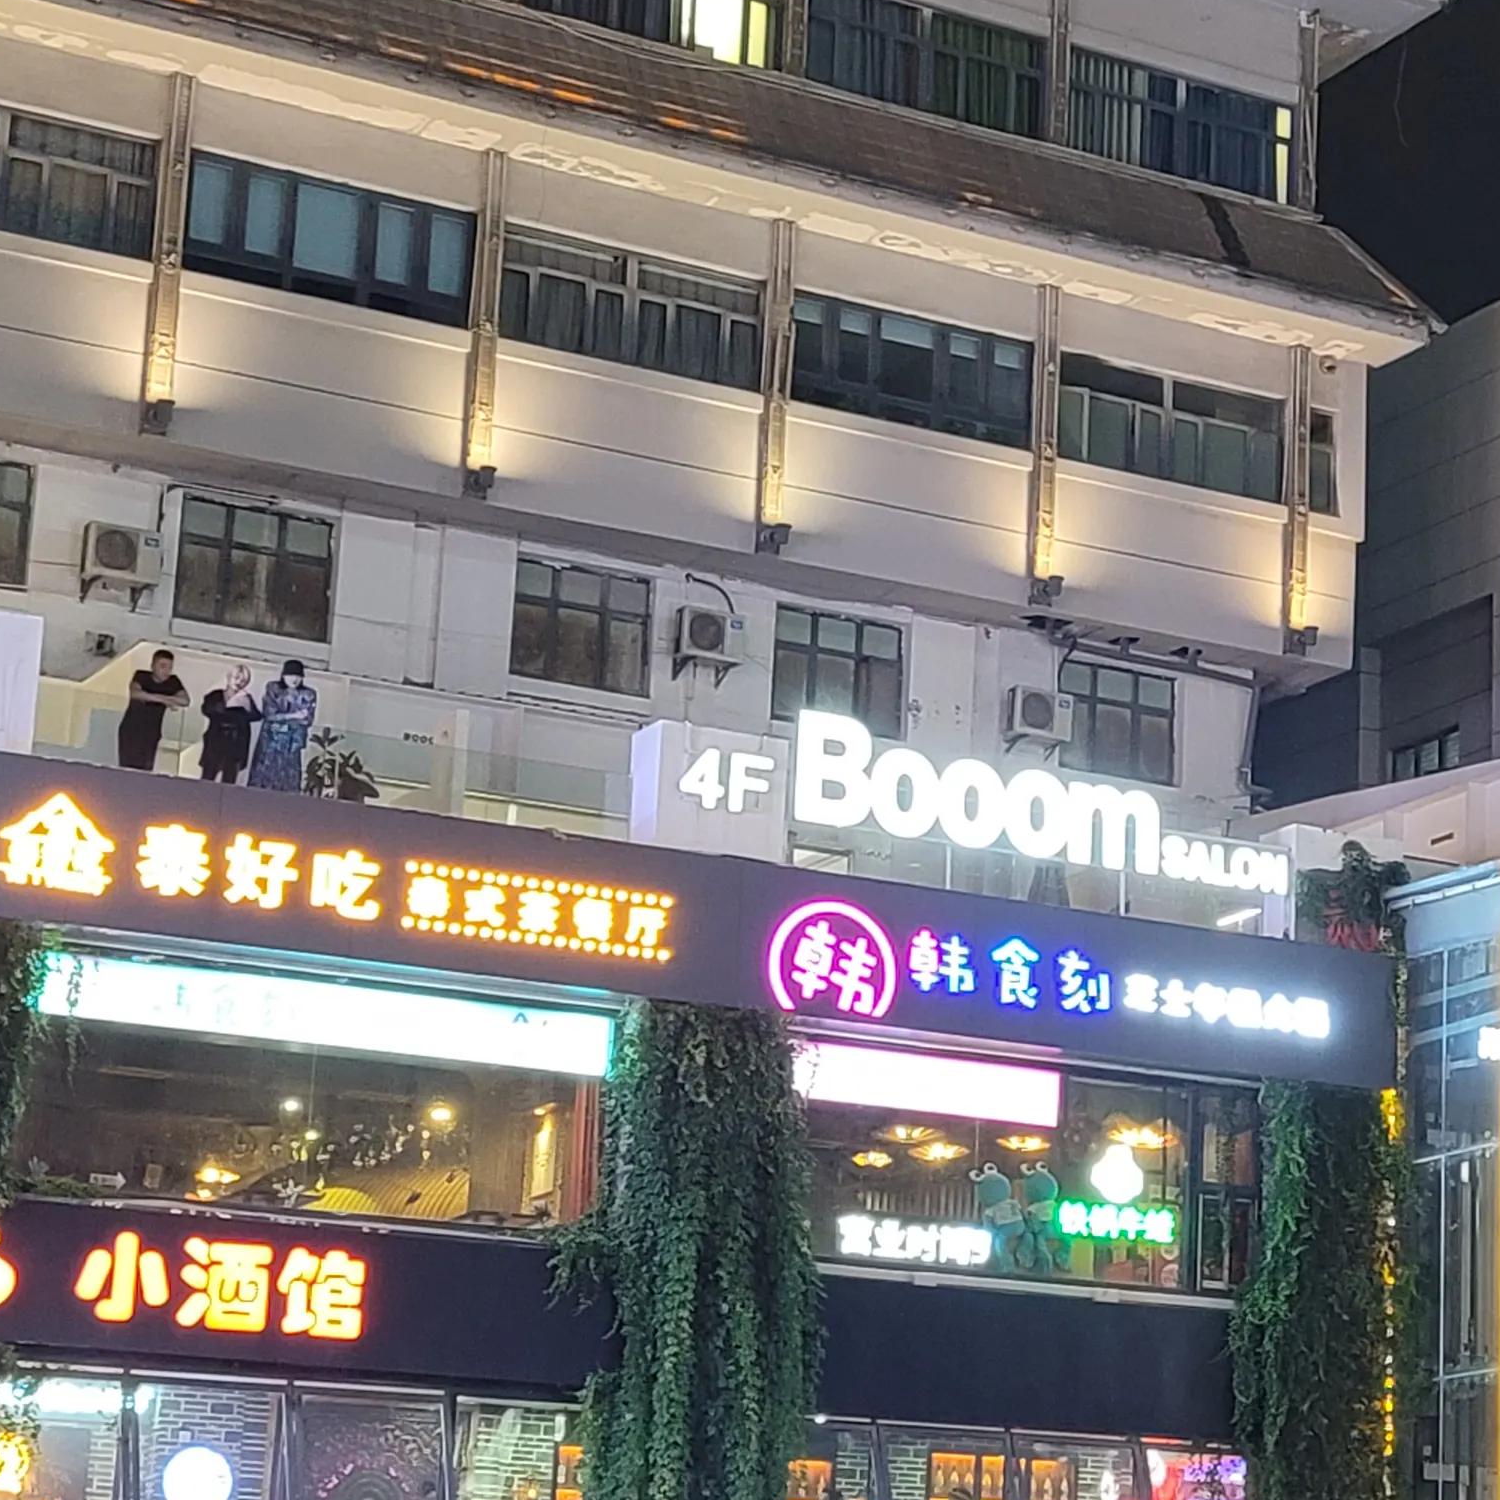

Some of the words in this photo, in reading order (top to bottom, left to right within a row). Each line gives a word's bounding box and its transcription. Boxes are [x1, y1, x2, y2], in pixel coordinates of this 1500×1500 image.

[139, 823, 381, 922] 泰好吃
[678, 747, 775, 813] 4F
[1162, 835, 1290, 897] SALON
[790, 920, 880, 1016] 韩
[908, 928, 1111, 1014] 韩食刻
[74, 1230, 368, 1342] 小酒馆
